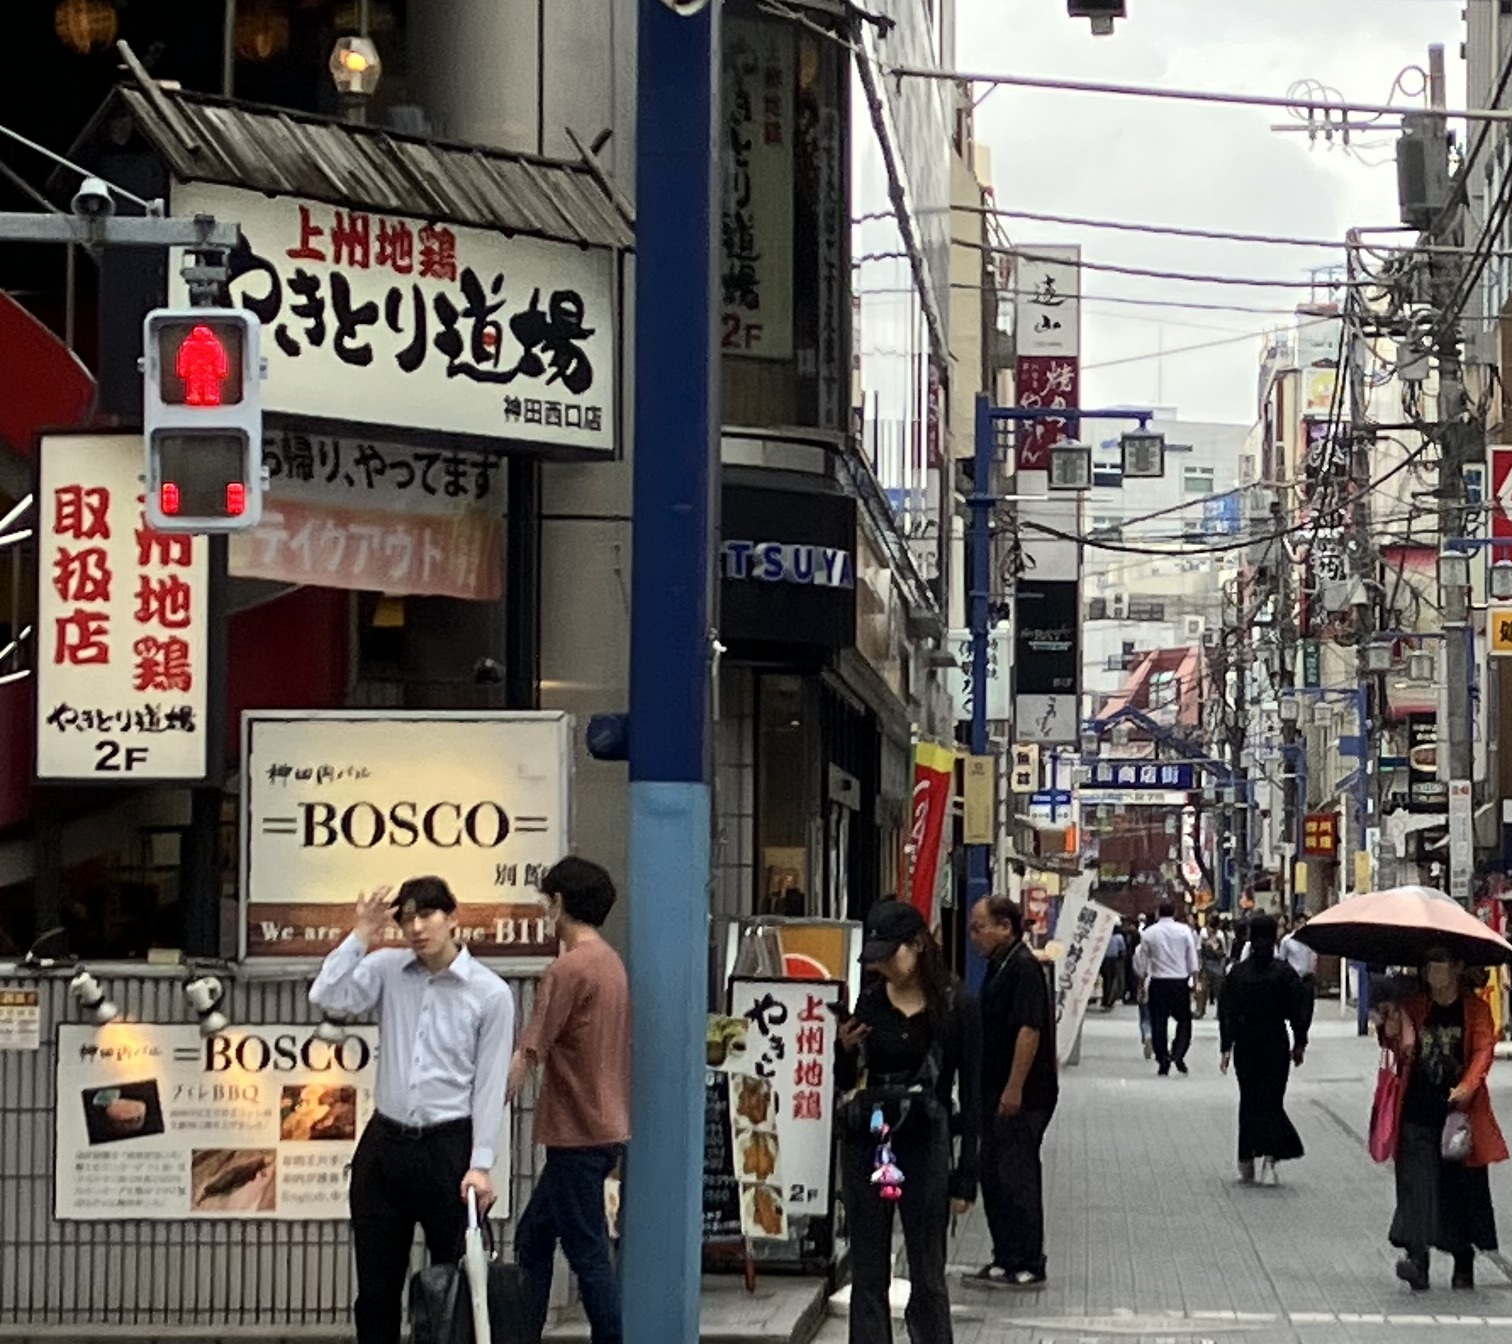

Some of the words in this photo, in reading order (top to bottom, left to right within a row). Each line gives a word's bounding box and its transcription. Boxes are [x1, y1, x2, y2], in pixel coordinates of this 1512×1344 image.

[286, 204, 459, 283] 上州地鶏
[228, 233, 596, 395] やきとり道場
[720, 312, 763, 350] 2F
[503, 395, 603, 432] 神田西口店
[53, 484, 111, 665] 取扱店
[252, 511, 447, 583] テイクアウト
[134, 492, 192, 693] 州地鶏
[47, 702, 197, 733] やきとり道場
[93, 740, 149, 772] 2F
[793, 992, 826, 1122] 上州地鶏
